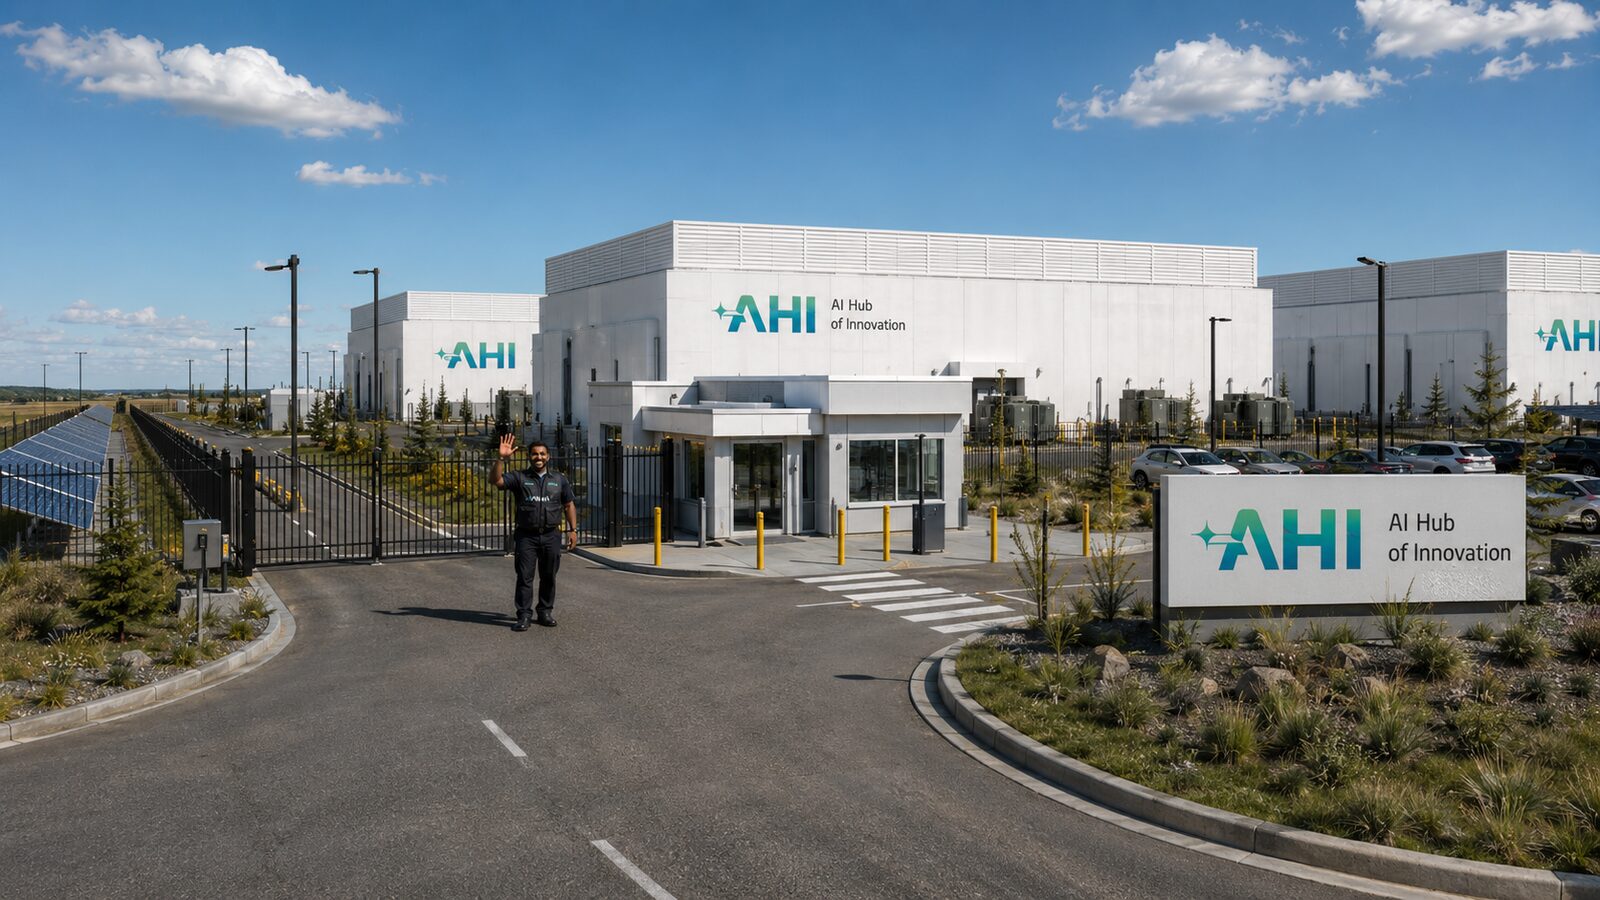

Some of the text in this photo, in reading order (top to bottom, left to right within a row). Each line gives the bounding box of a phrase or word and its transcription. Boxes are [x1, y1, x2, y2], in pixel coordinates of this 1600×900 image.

[728, 295, 816, 334] AHI
[831, 299, 873, 312] AI Hub
[831, 317, 906, 331] of Innovation
[447, 342, 516, 369] AHI
[1388, 513, 1455, 532] AI Hub
[1218, 508, 1362, 571] AHI
[1388, 543, 1512, 562] of Innovation
